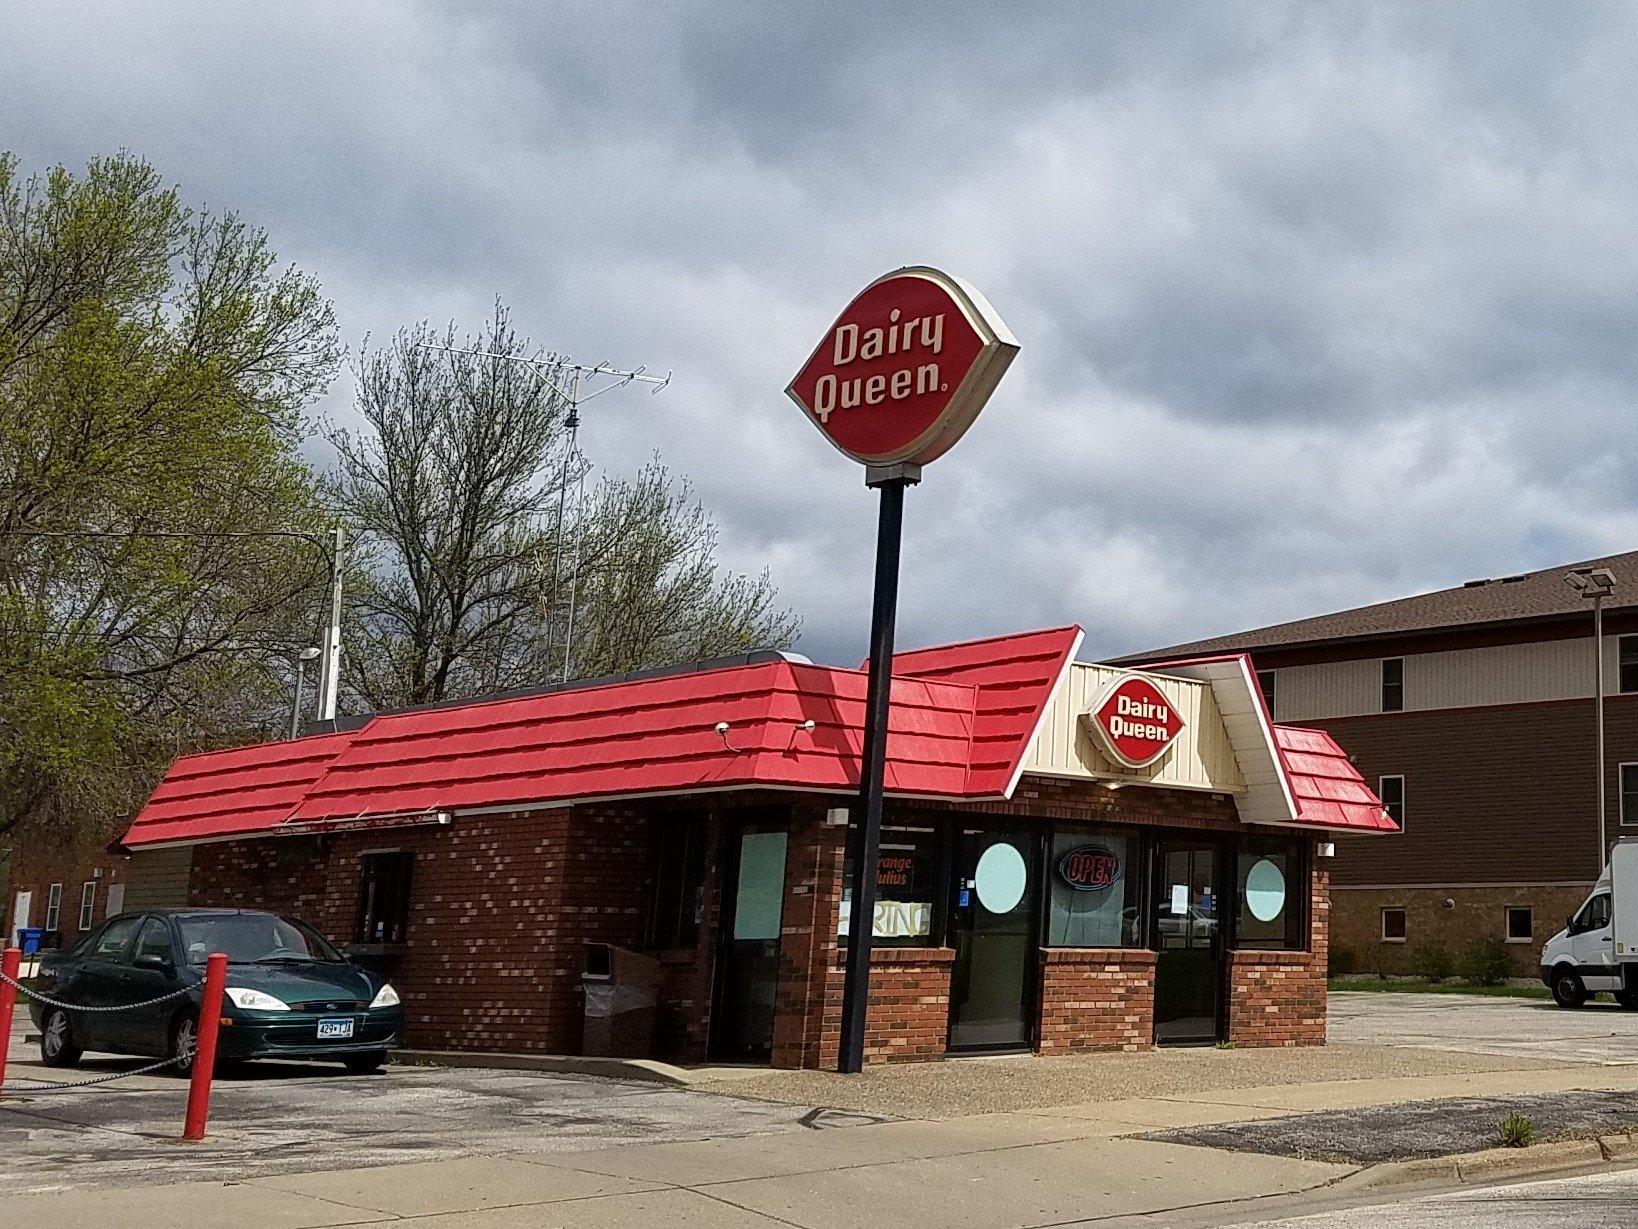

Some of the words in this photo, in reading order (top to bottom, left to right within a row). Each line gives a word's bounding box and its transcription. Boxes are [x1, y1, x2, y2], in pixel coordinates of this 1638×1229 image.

[833, 308, 946, 366] Dairy
[814, 363, 940, 424] Queen
[1117, 694, 1168, 724] Dairy
[1110, 715, 1168, 742] Queen
[875, 857, 912, 873] range
[1067, 853, 1116, 886] OPEN
